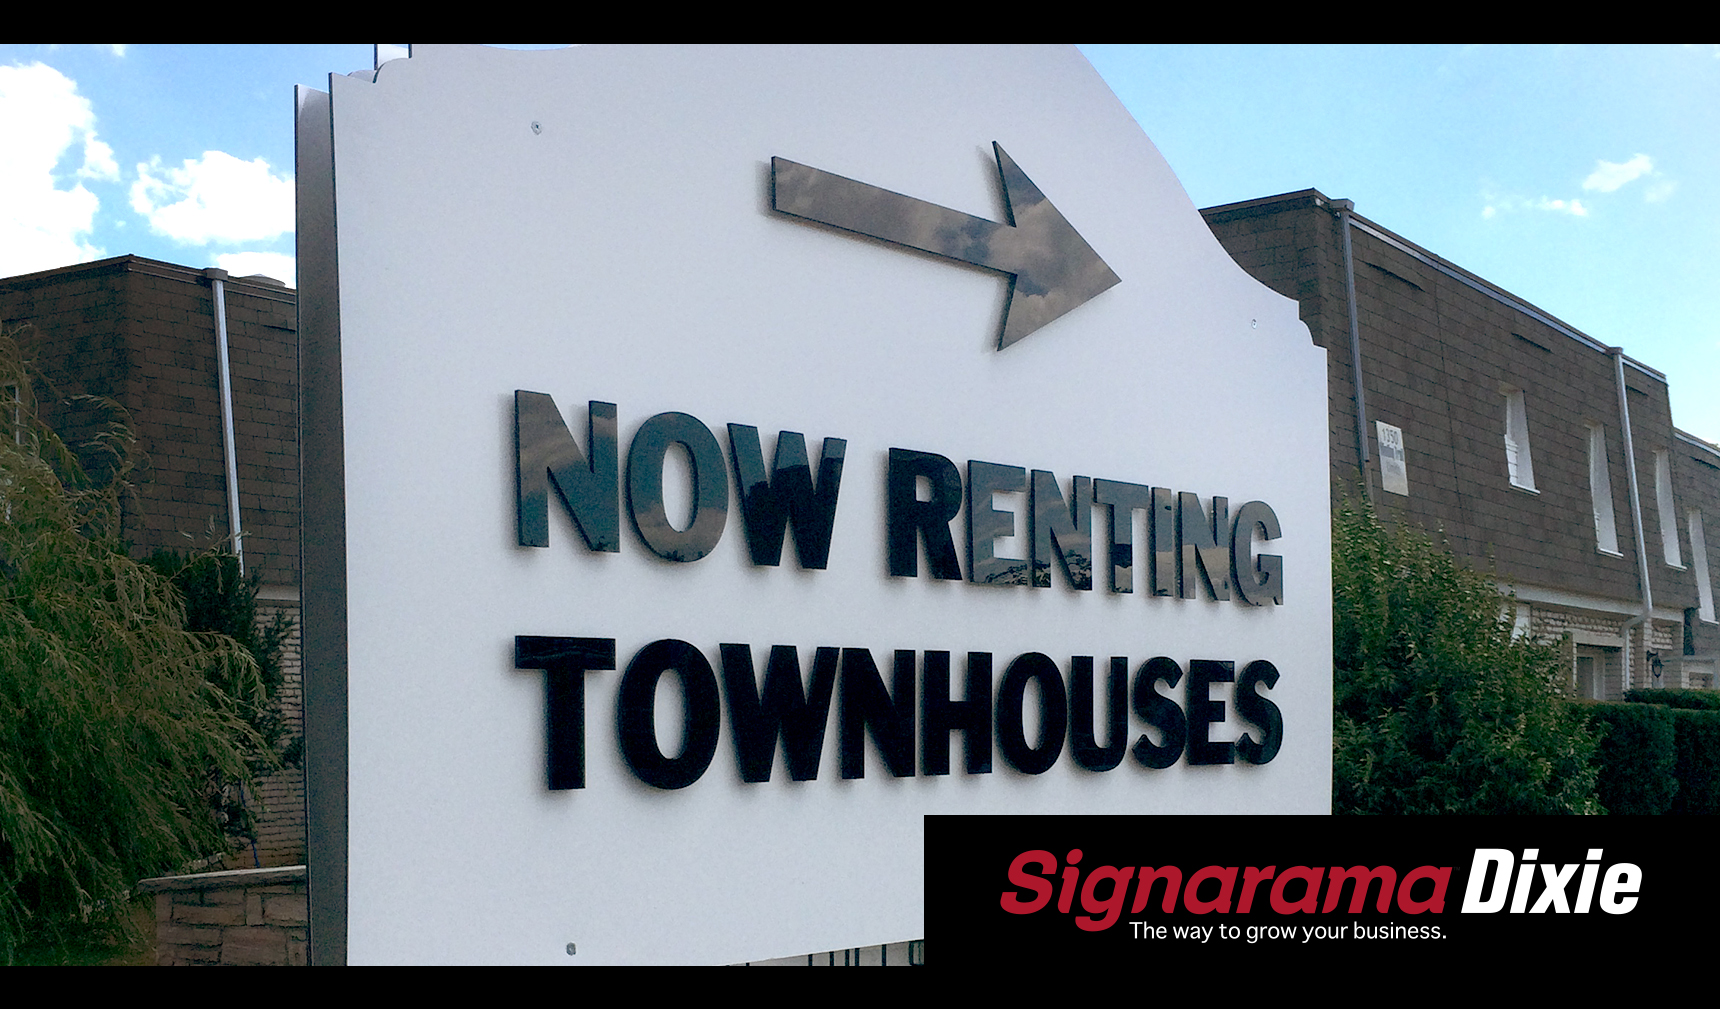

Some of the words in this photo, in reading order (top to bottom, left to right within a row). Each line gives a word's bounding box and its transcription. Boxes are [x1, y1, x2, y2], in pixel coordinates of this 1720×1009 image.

[514, 389, 847, 570] NOW
[888, 446, 1284, 607] RENTING
[514, 635, 1284, 791] TOWNHOUSES
